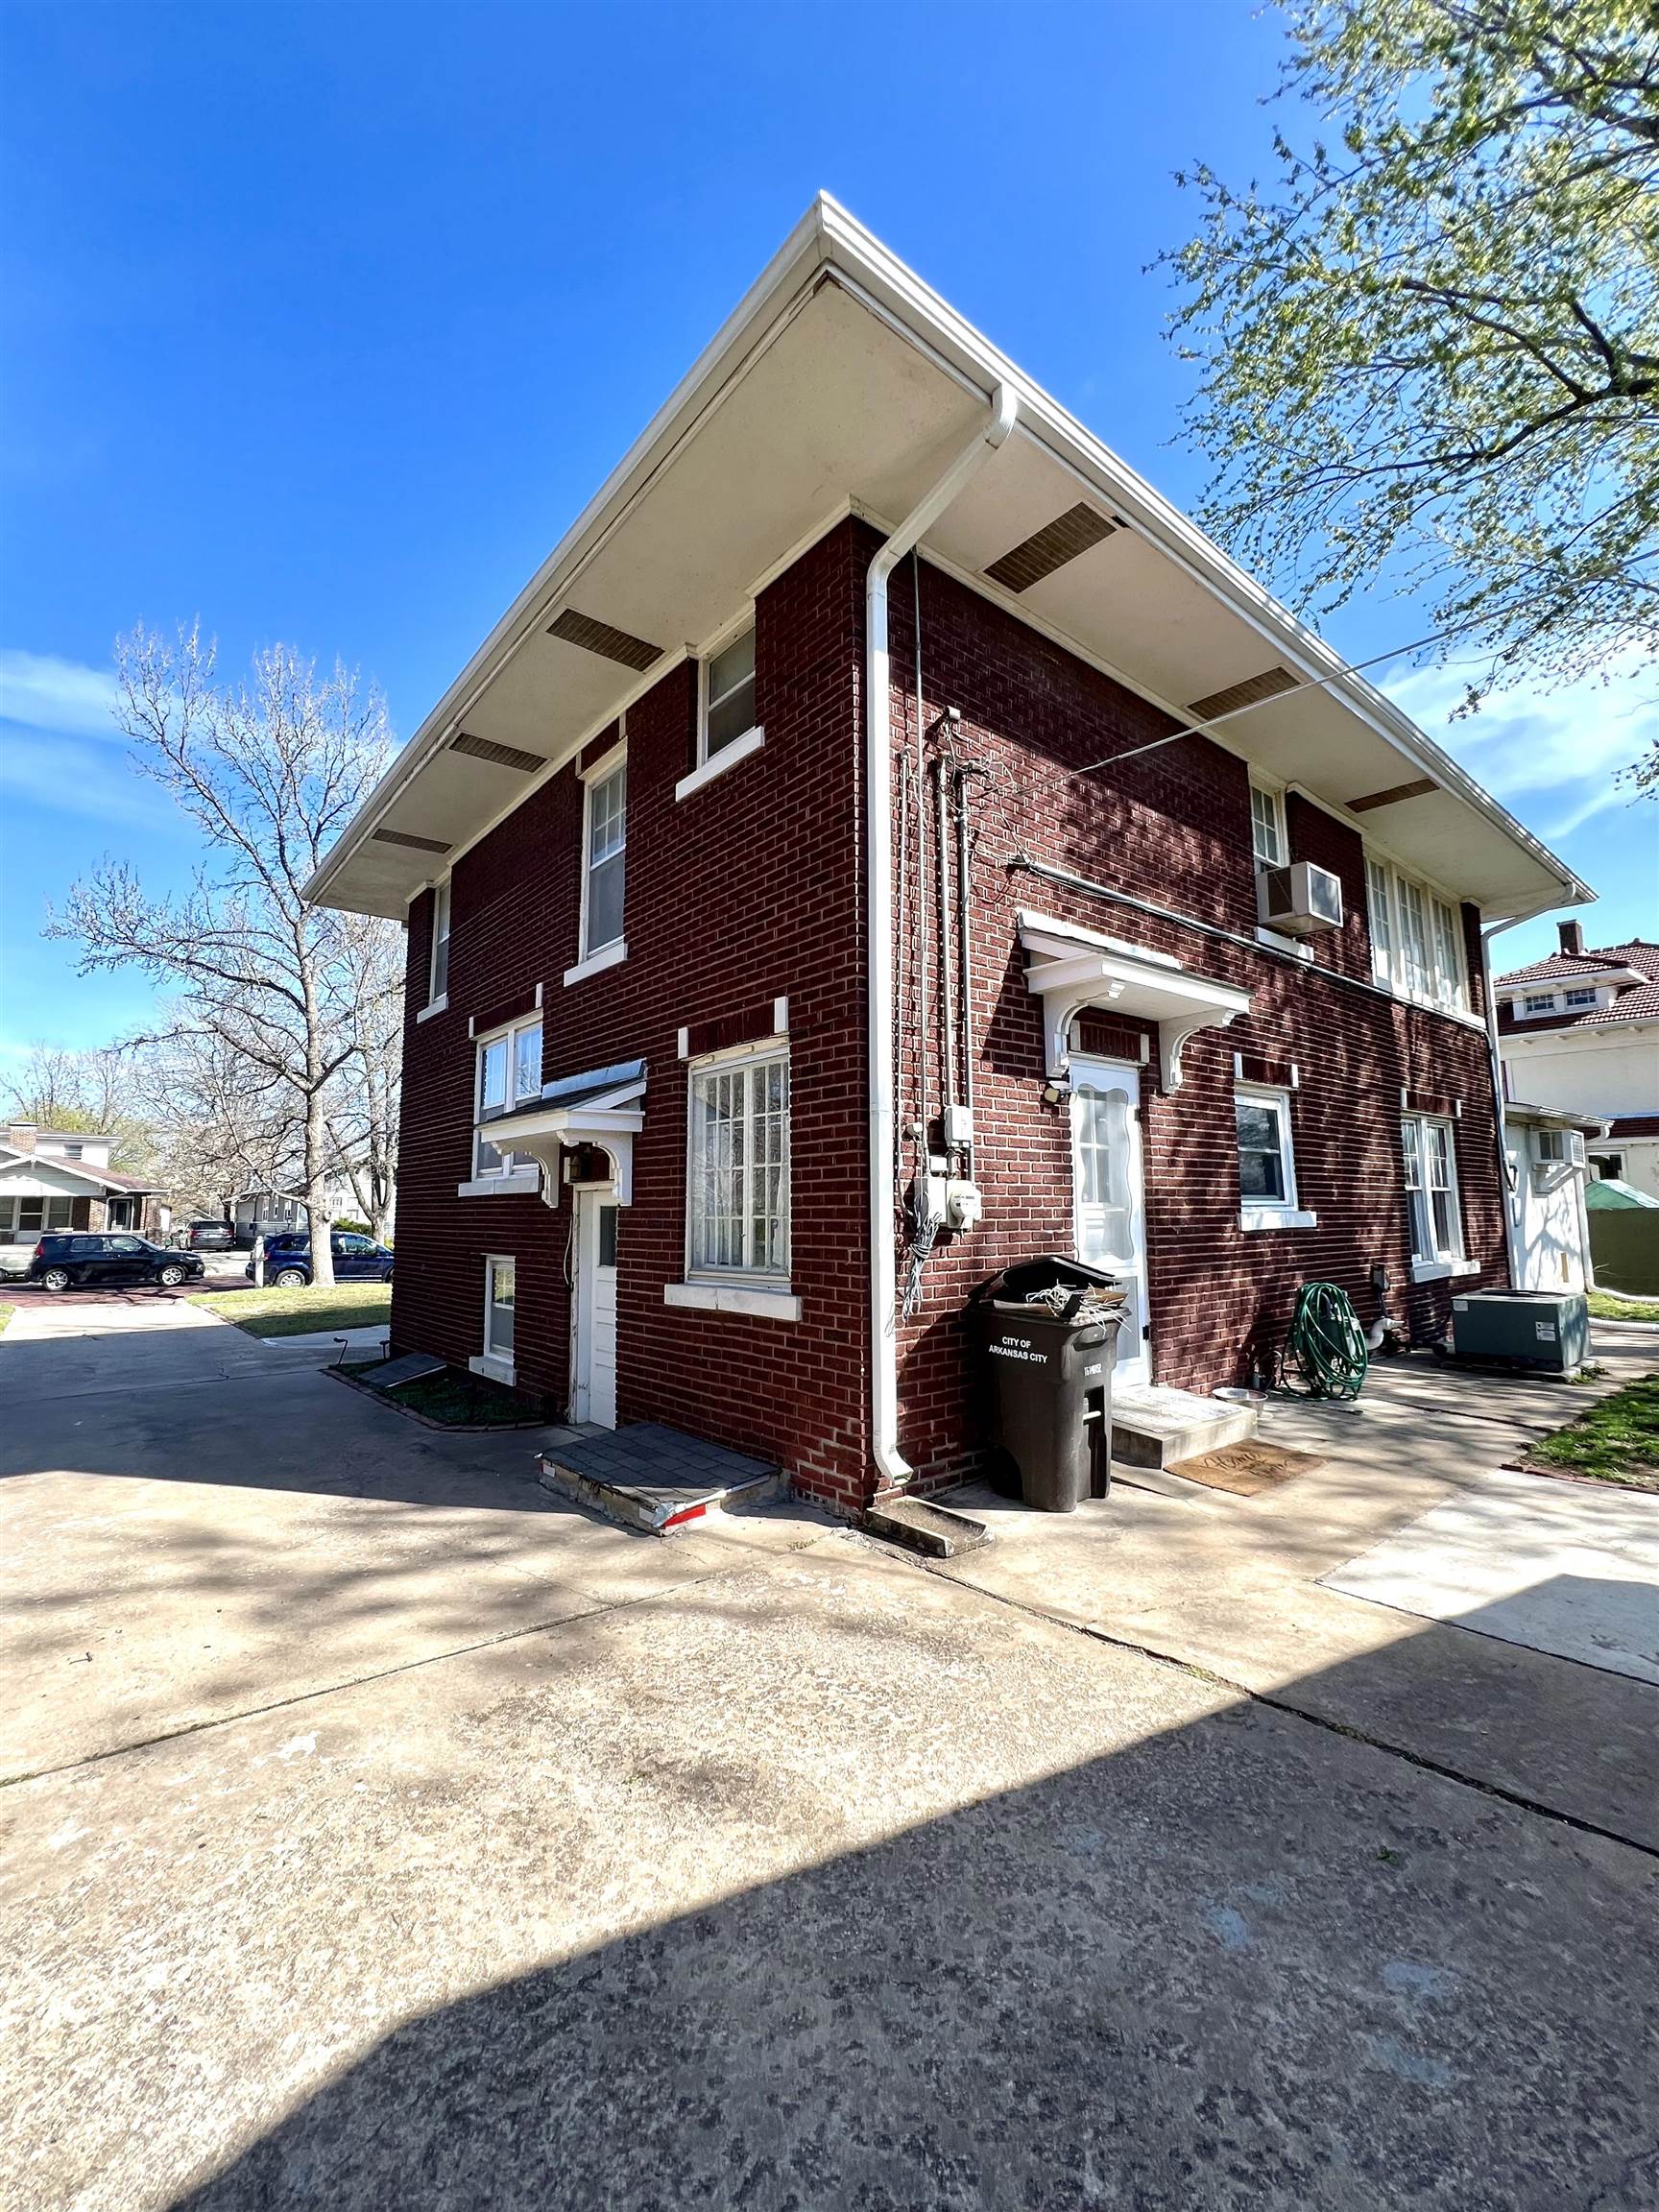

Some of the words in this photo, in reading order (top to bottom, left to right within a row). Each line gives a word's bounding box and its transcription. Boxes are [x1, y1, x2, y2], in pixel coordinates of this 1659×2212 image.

[1001, 1336, 1020, 1347] CITY
[1020, 1339, 1032, 1349] OF
[989, 1344, 1028, 1360] ARKANSAS
[1029, 1353, 1048, 1363] CITY
